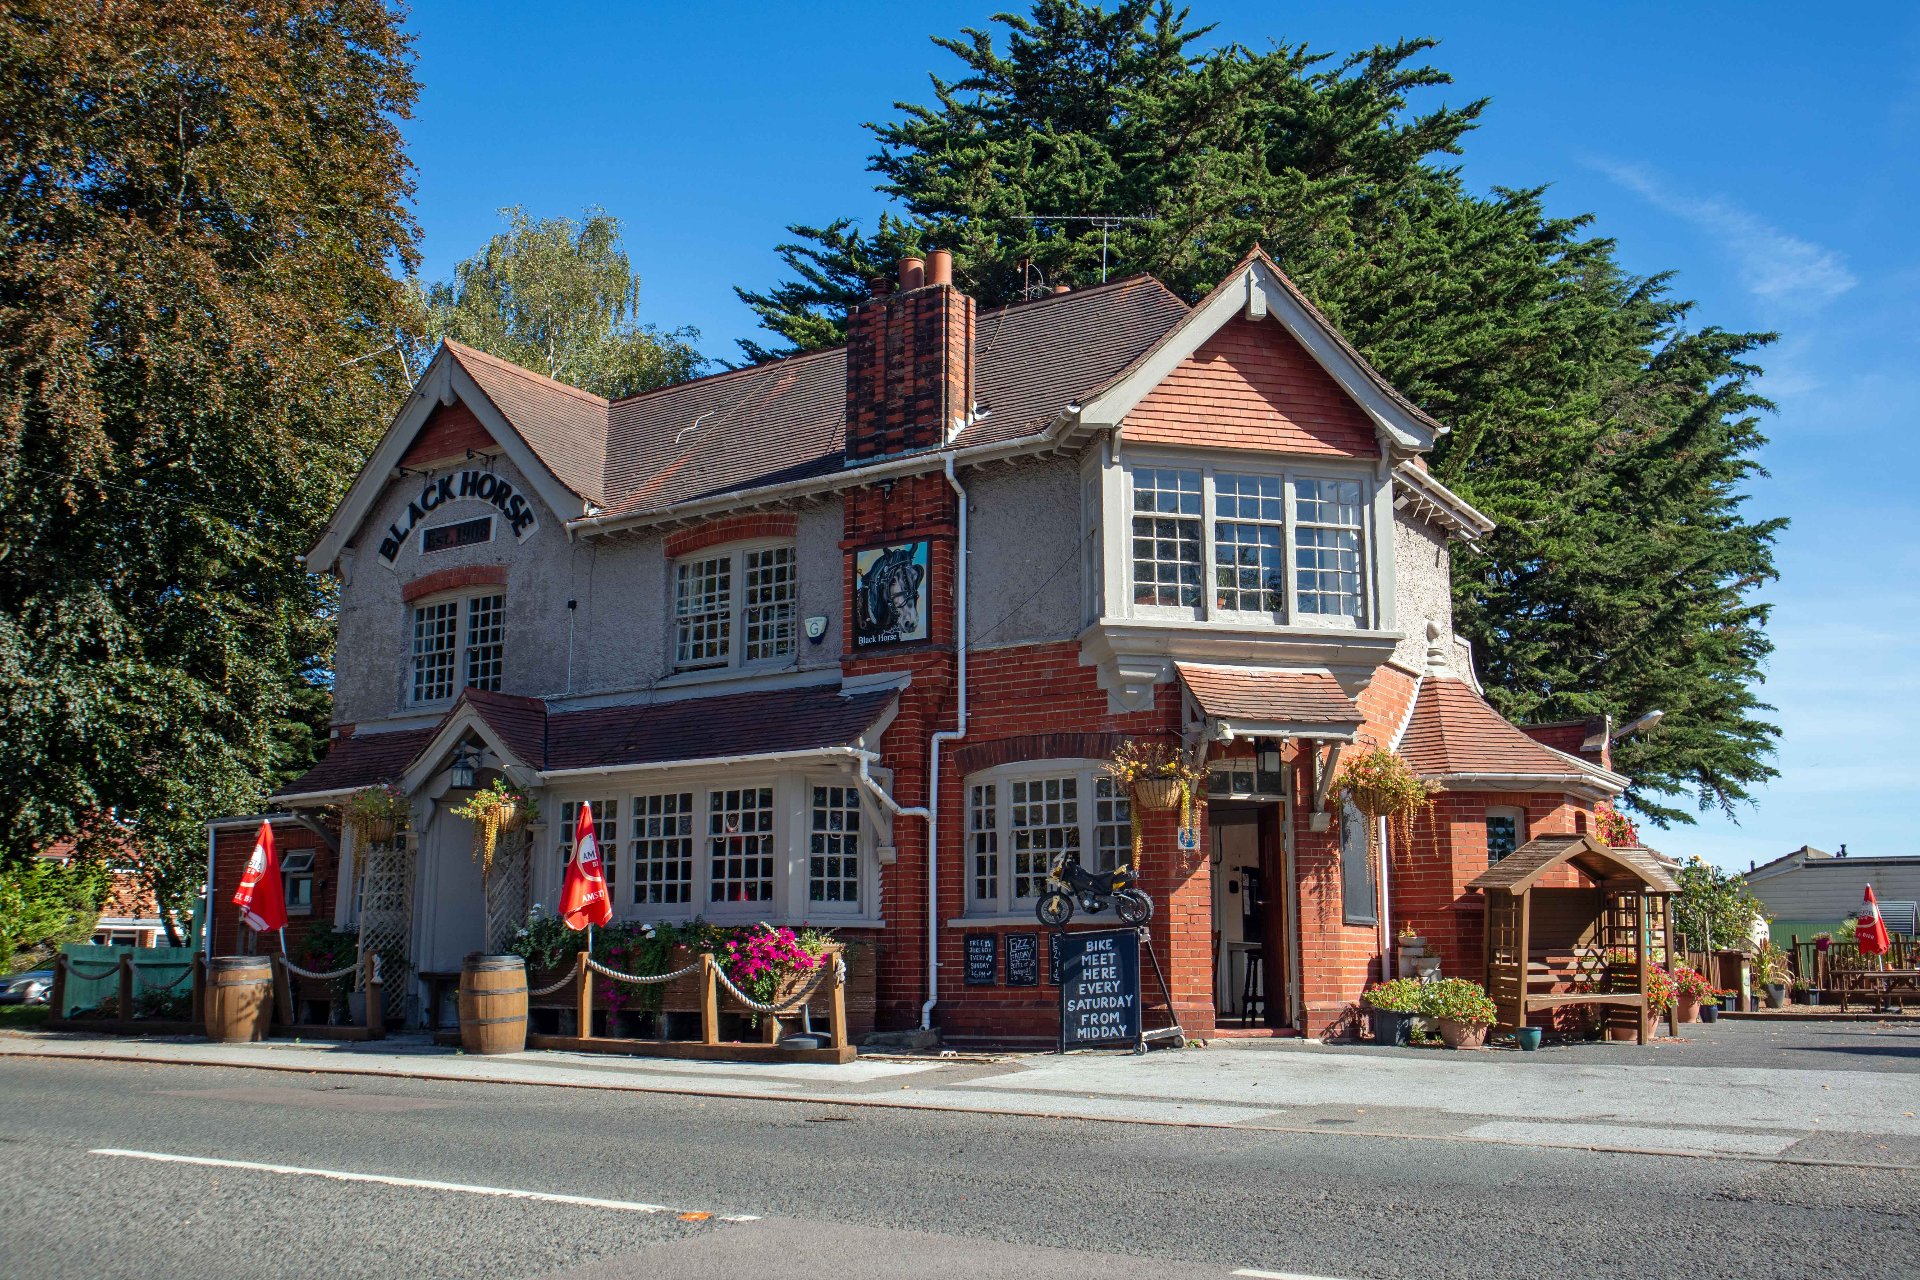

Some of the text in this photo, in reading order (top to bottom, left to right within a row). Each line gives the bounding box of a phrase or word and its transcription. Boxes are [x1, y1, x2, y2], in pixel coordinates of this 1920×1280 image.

[378, 470, 534, 563] BLACK HORSE
[810, 623, 818, 635] G
[858, 634, 897, 645] Black Horse
[969, 939, 984, 947] FREE
[1086, 938, 1113, 952] BIKE
[1010, 950, 1032, 961] FRIDAY
[1081, 952, 1116, 966] MEET
[970, 962, 990, 970] SUNDAY
[1083, 966, 1117, 980] HERE
[1078, 980, 1121, 995] EVERY
[1067, 994, 1133, 1012] SATURDAY
[1081, 1011, 1120, 1026] FROM
[1077, 1025, 1128, 1039] MIDDAY
